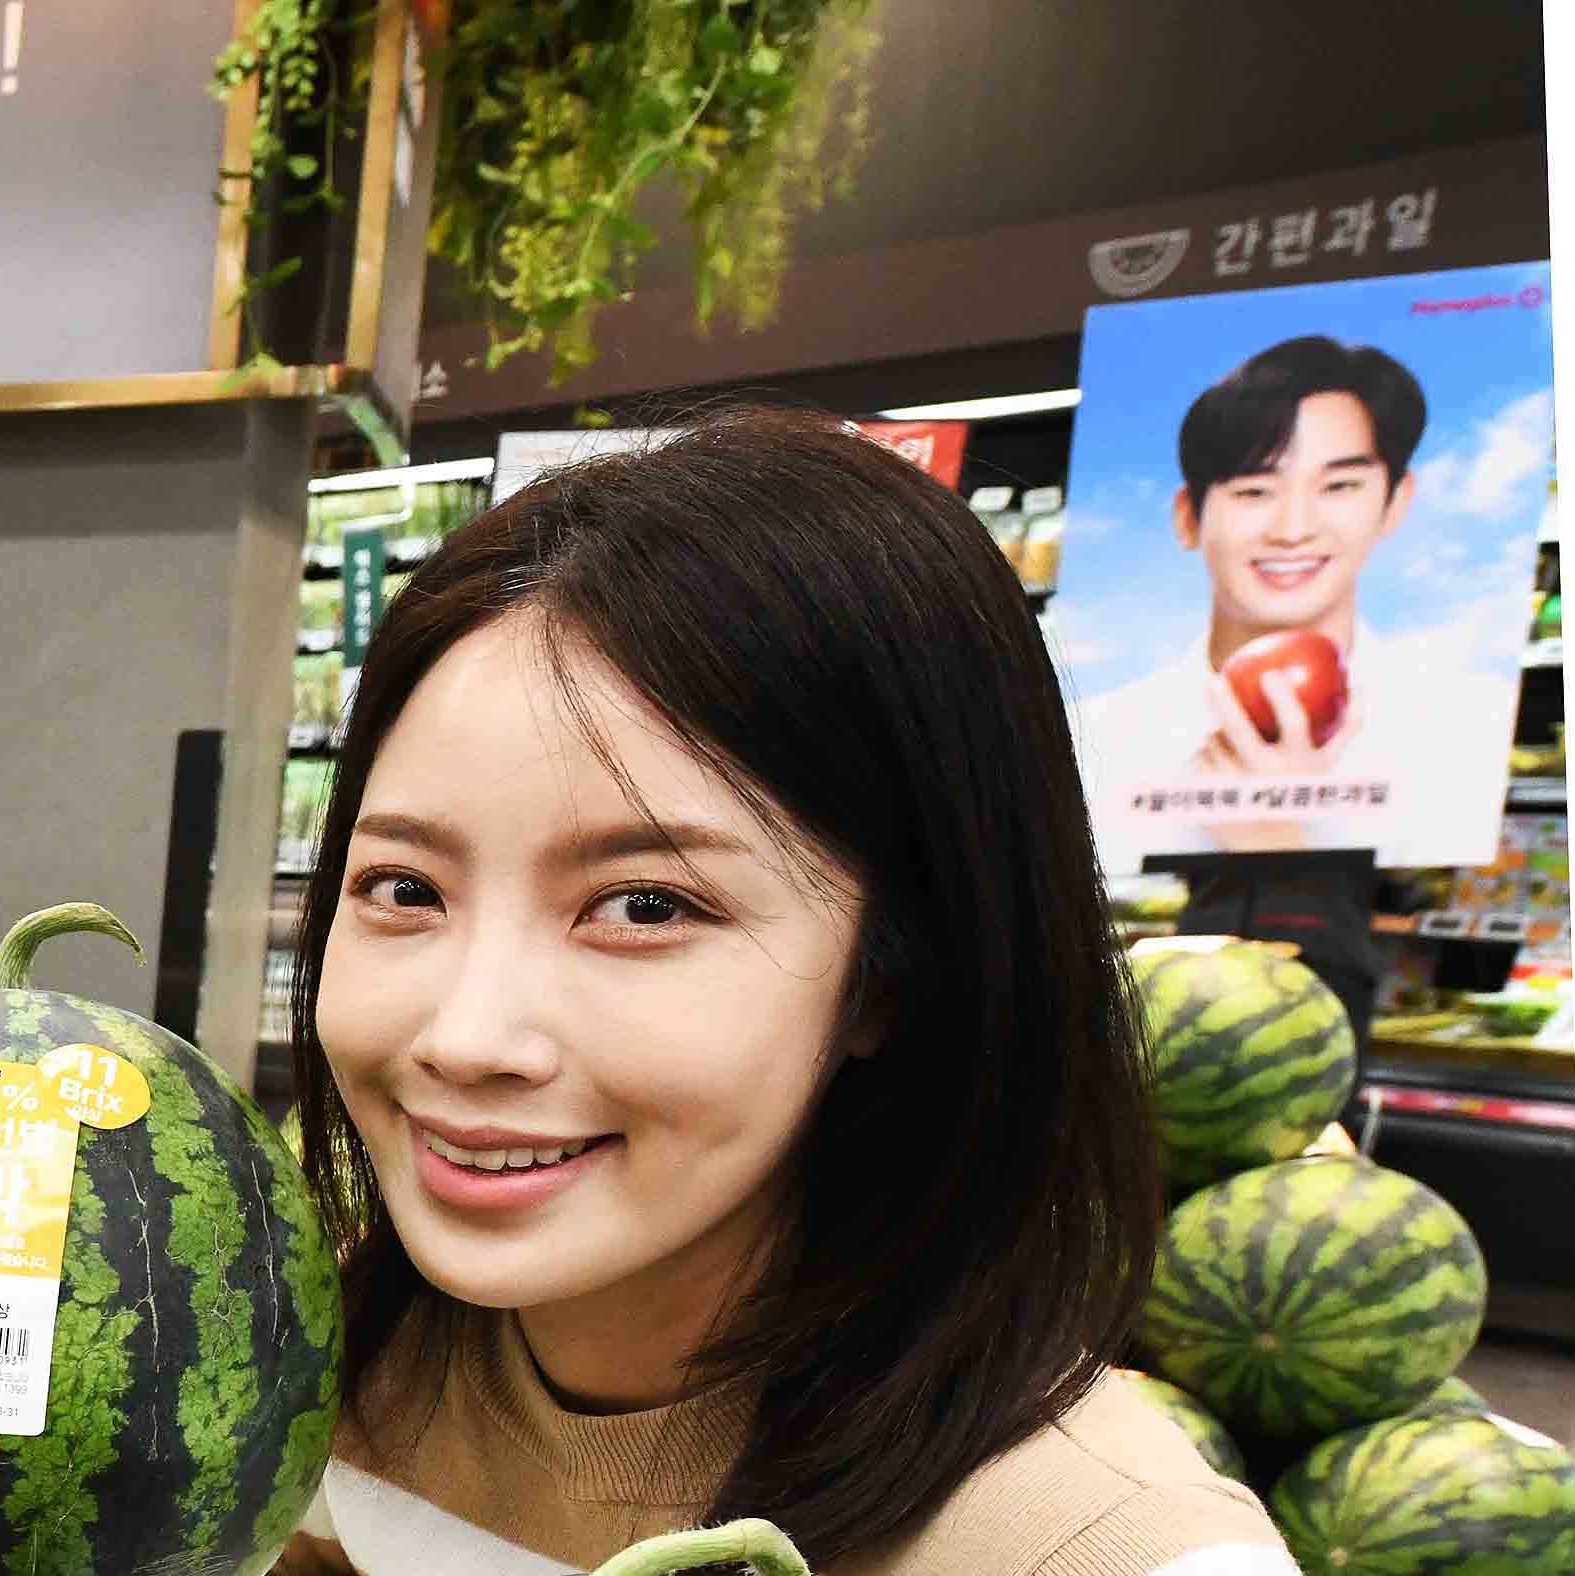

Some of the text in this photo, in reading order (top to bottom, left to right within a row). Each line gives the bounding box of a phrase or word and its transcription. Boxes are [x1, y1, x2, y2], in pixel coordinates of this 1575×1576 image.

[1213, 187, 1439, 277] 간편과일
[75, 1050, 119, 1087] 11
[59, 1078, 124, 1114] Brix
